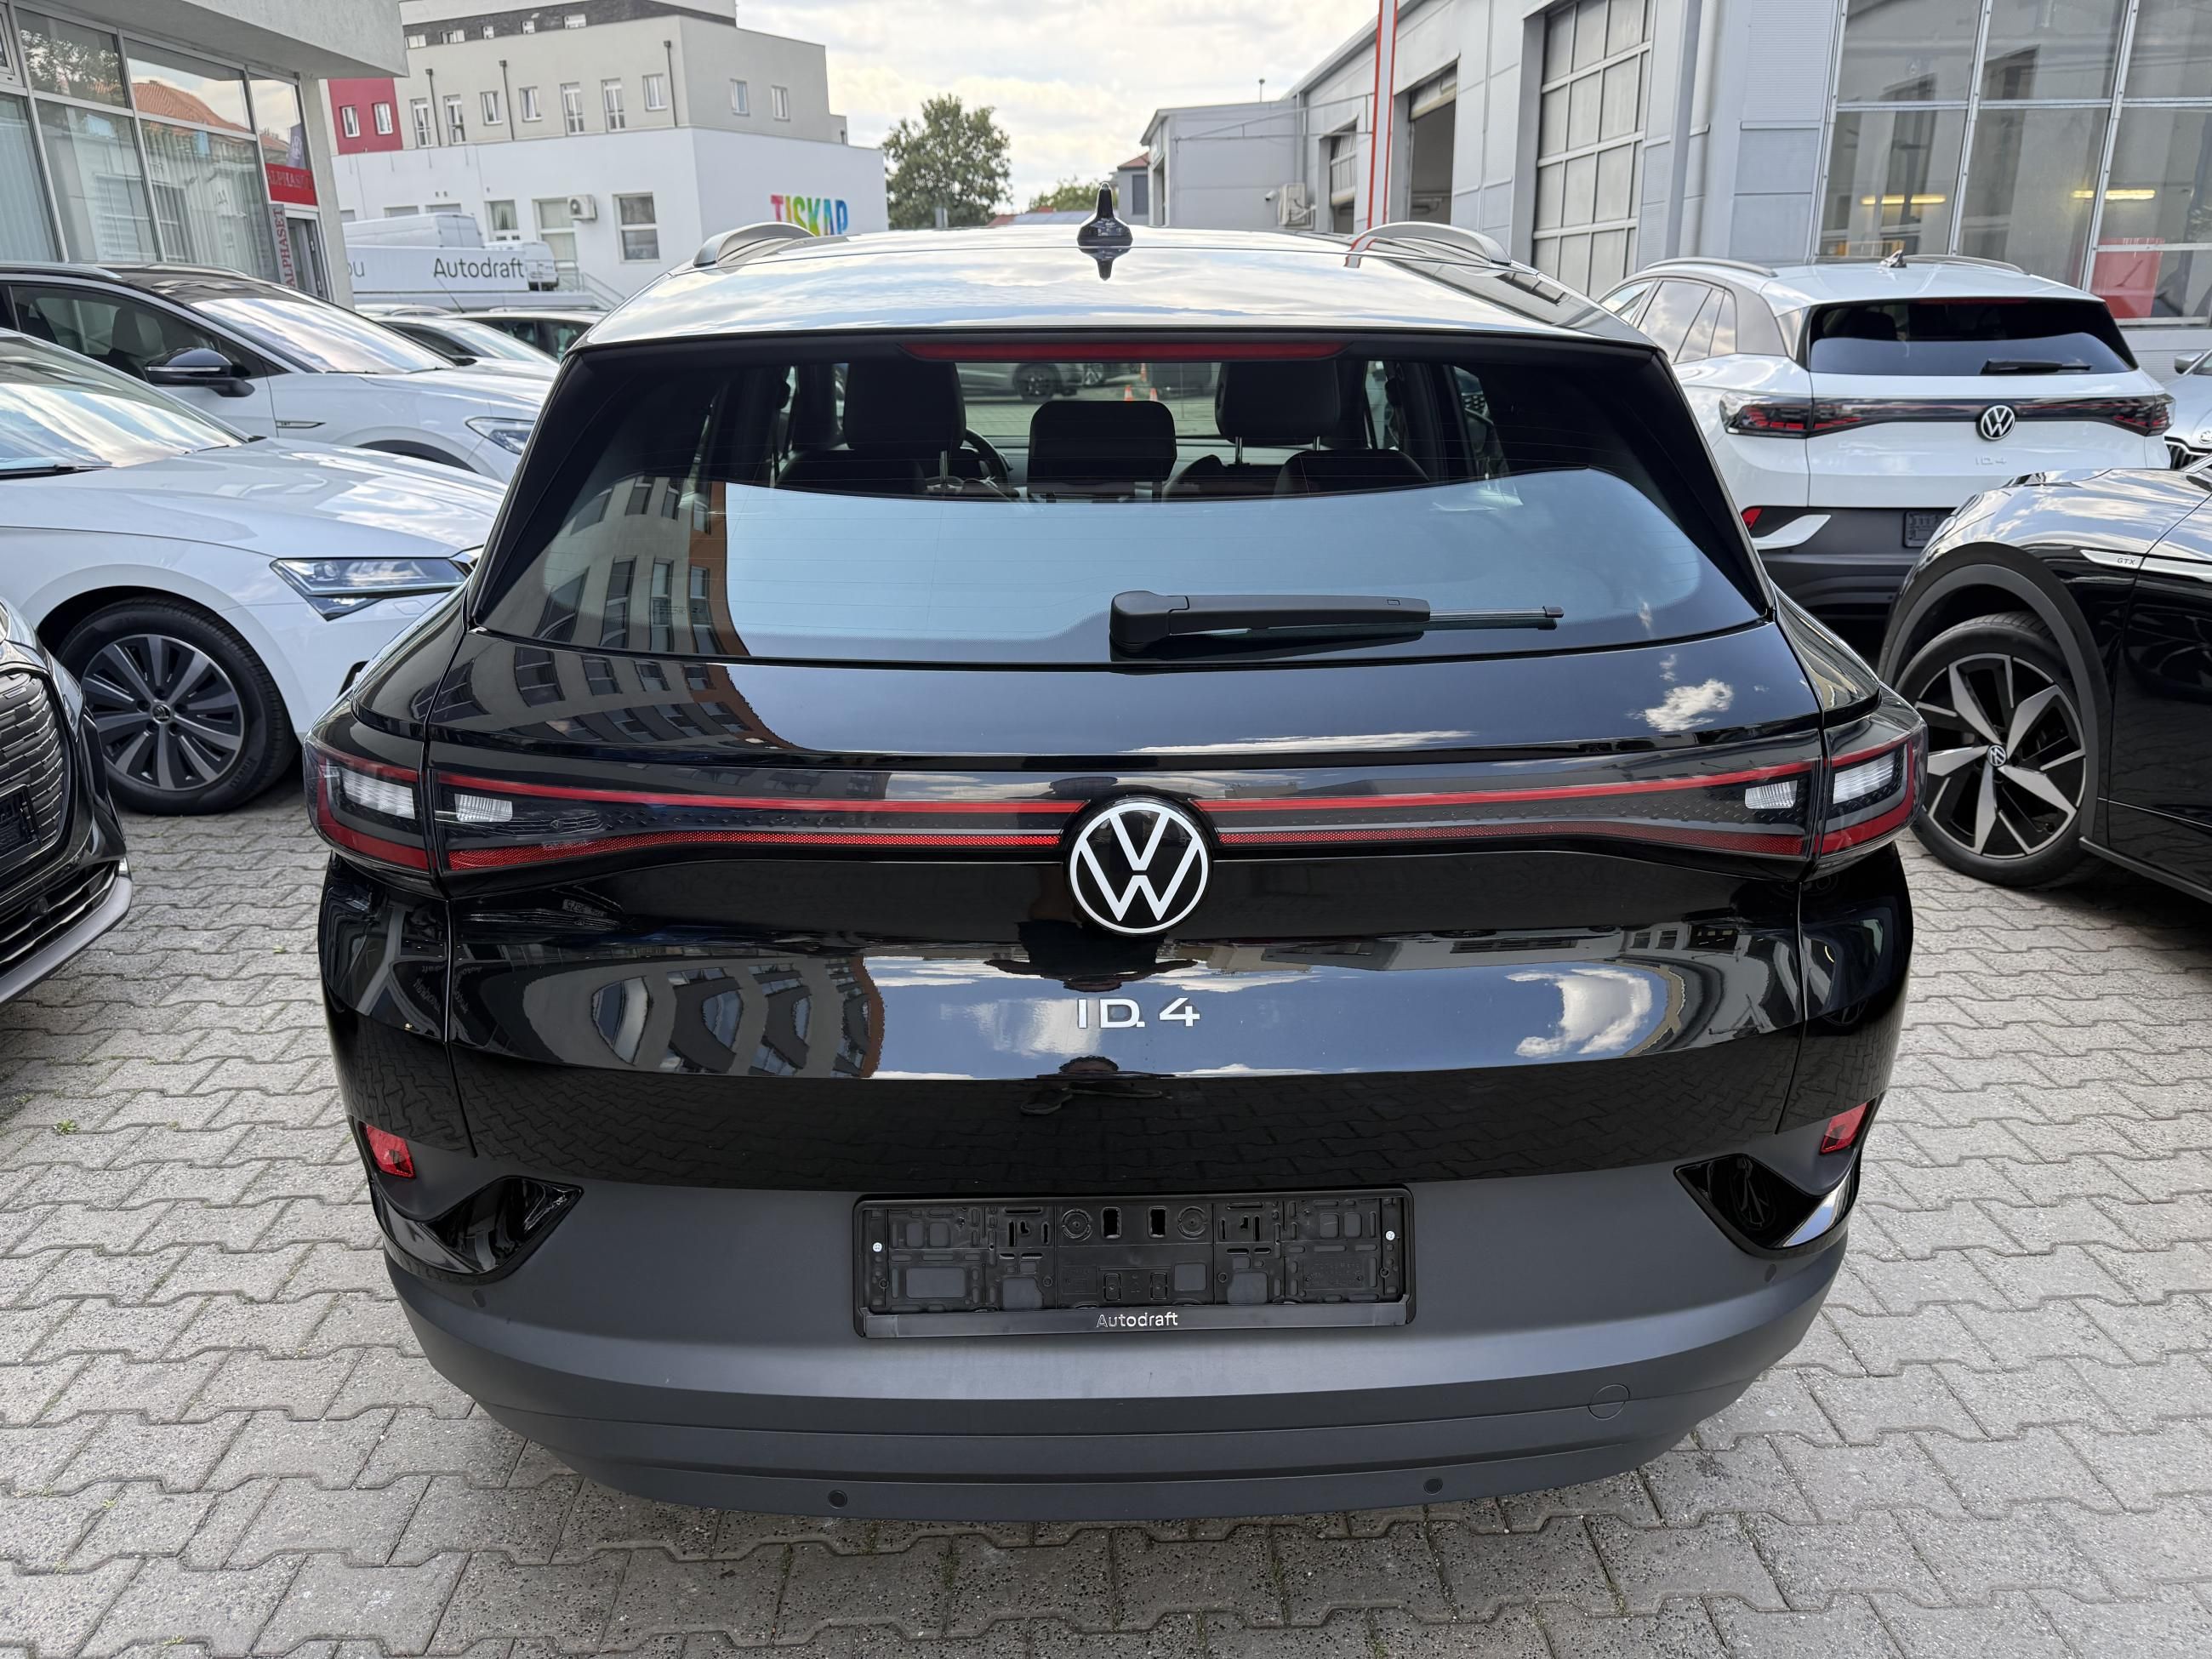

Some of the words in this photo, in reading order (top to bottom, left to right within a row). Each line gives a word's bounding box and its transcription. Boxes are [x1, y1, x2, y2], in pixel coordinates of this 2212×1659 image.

[273, 208, 296, 288] ALPHASET
[433, 257, 525, 278] Autodraft
[1069, 802, 1209, 933] VW
[1097, 1311, 1178, 1328] Autodraft
